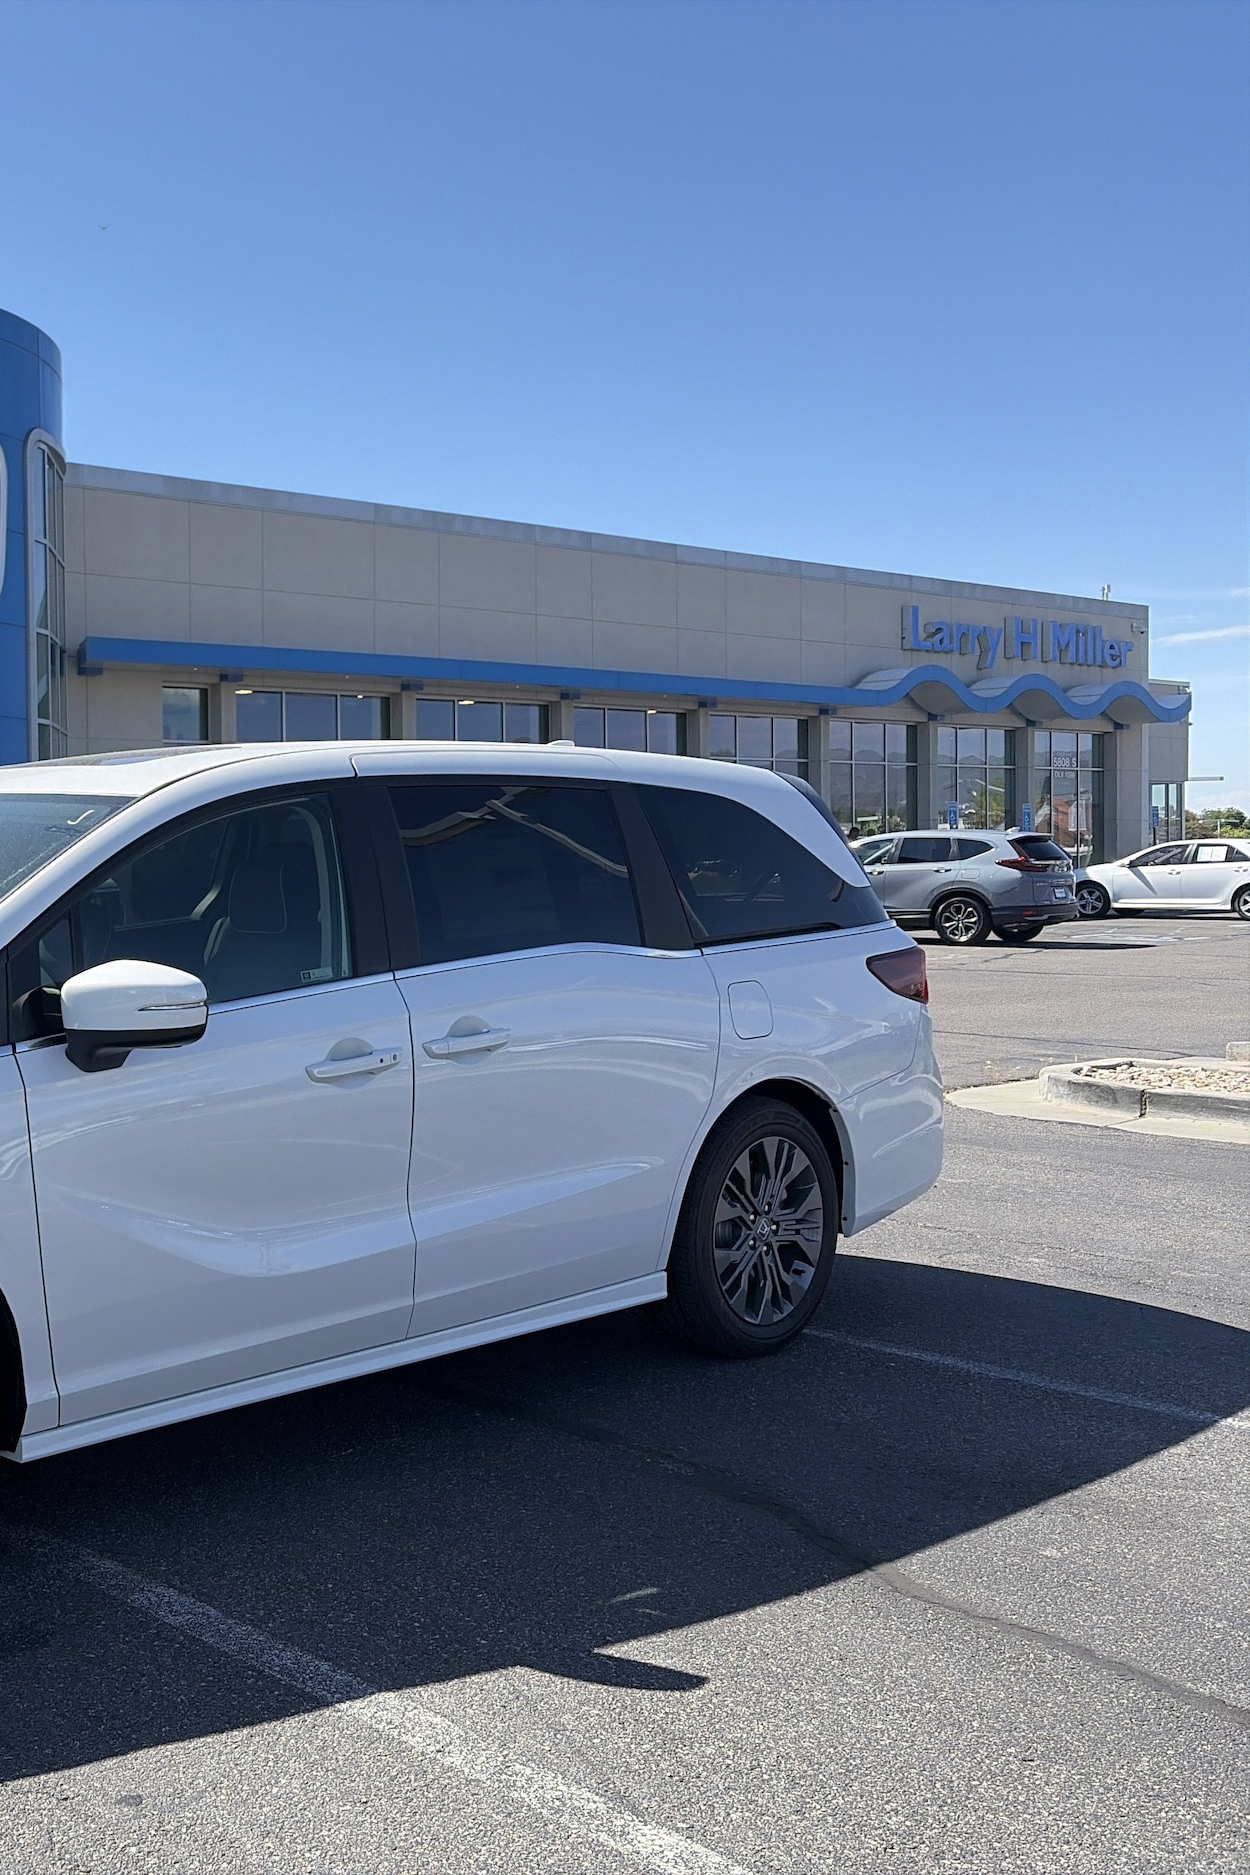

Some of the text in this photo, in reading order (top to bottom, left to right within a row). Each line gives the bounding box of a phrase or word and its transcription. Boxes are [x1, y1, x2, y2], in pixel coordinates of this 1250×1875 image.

[906, 605, 1134, 669] Larry H Miller
[1053, 757, 1077, 768] 5808 S
